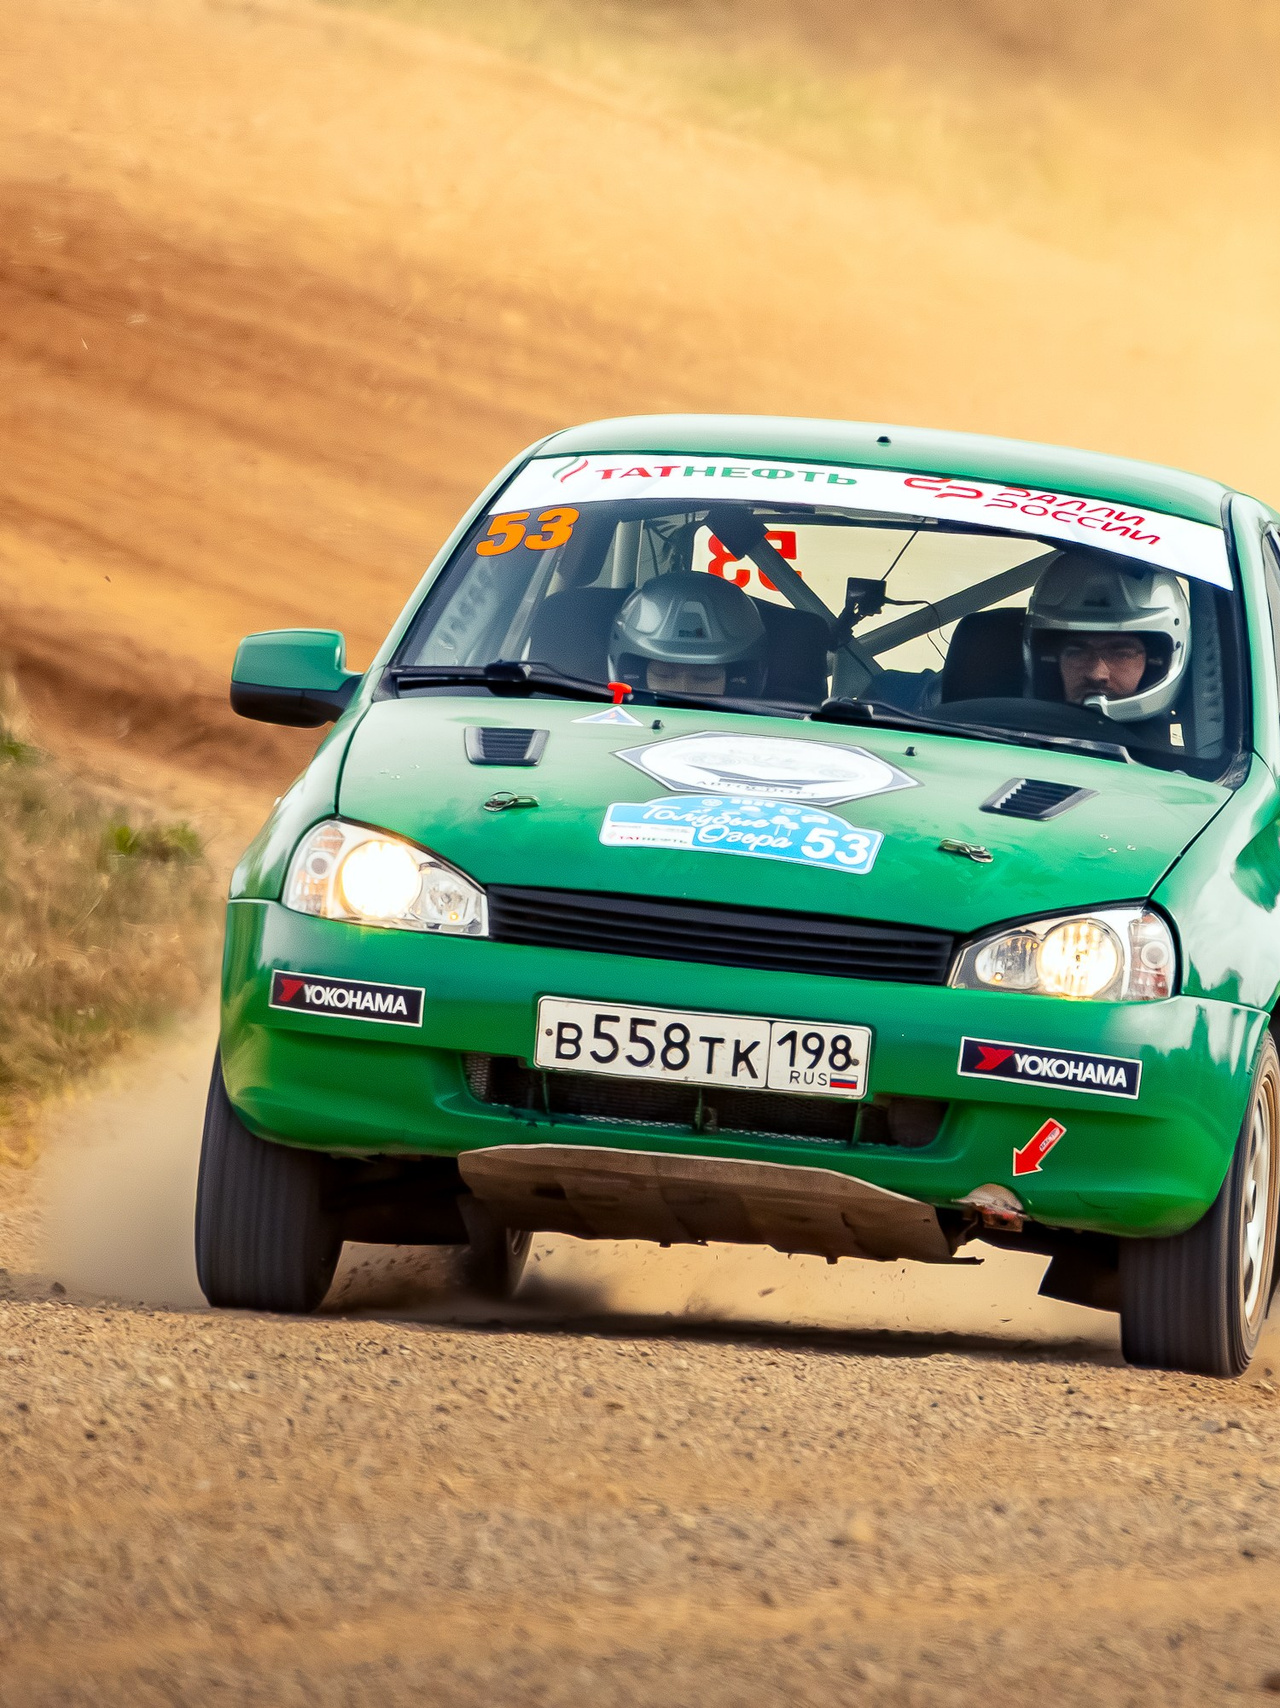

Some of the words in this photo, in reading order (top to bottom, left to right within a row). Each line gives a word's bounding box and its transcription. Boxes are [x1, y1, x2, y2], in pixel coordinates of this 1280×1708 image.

[595, 465, 857, 486] ТАТНЕФТЬ
[984, 498, 1161, 545] РОССИИ
[997, 486, 1146, 526] РАЛЛИ
[476, 507, 580, 557] 53
[801, 827, 871, 865] 53
[303, 984, 408, 1015] YOKOHAMA
[777, 1030, 852, 1072] 198
[789, 1070, 828, 1086] RUS
[1014, 1053, 1127, 1088] YOKOHAMA
